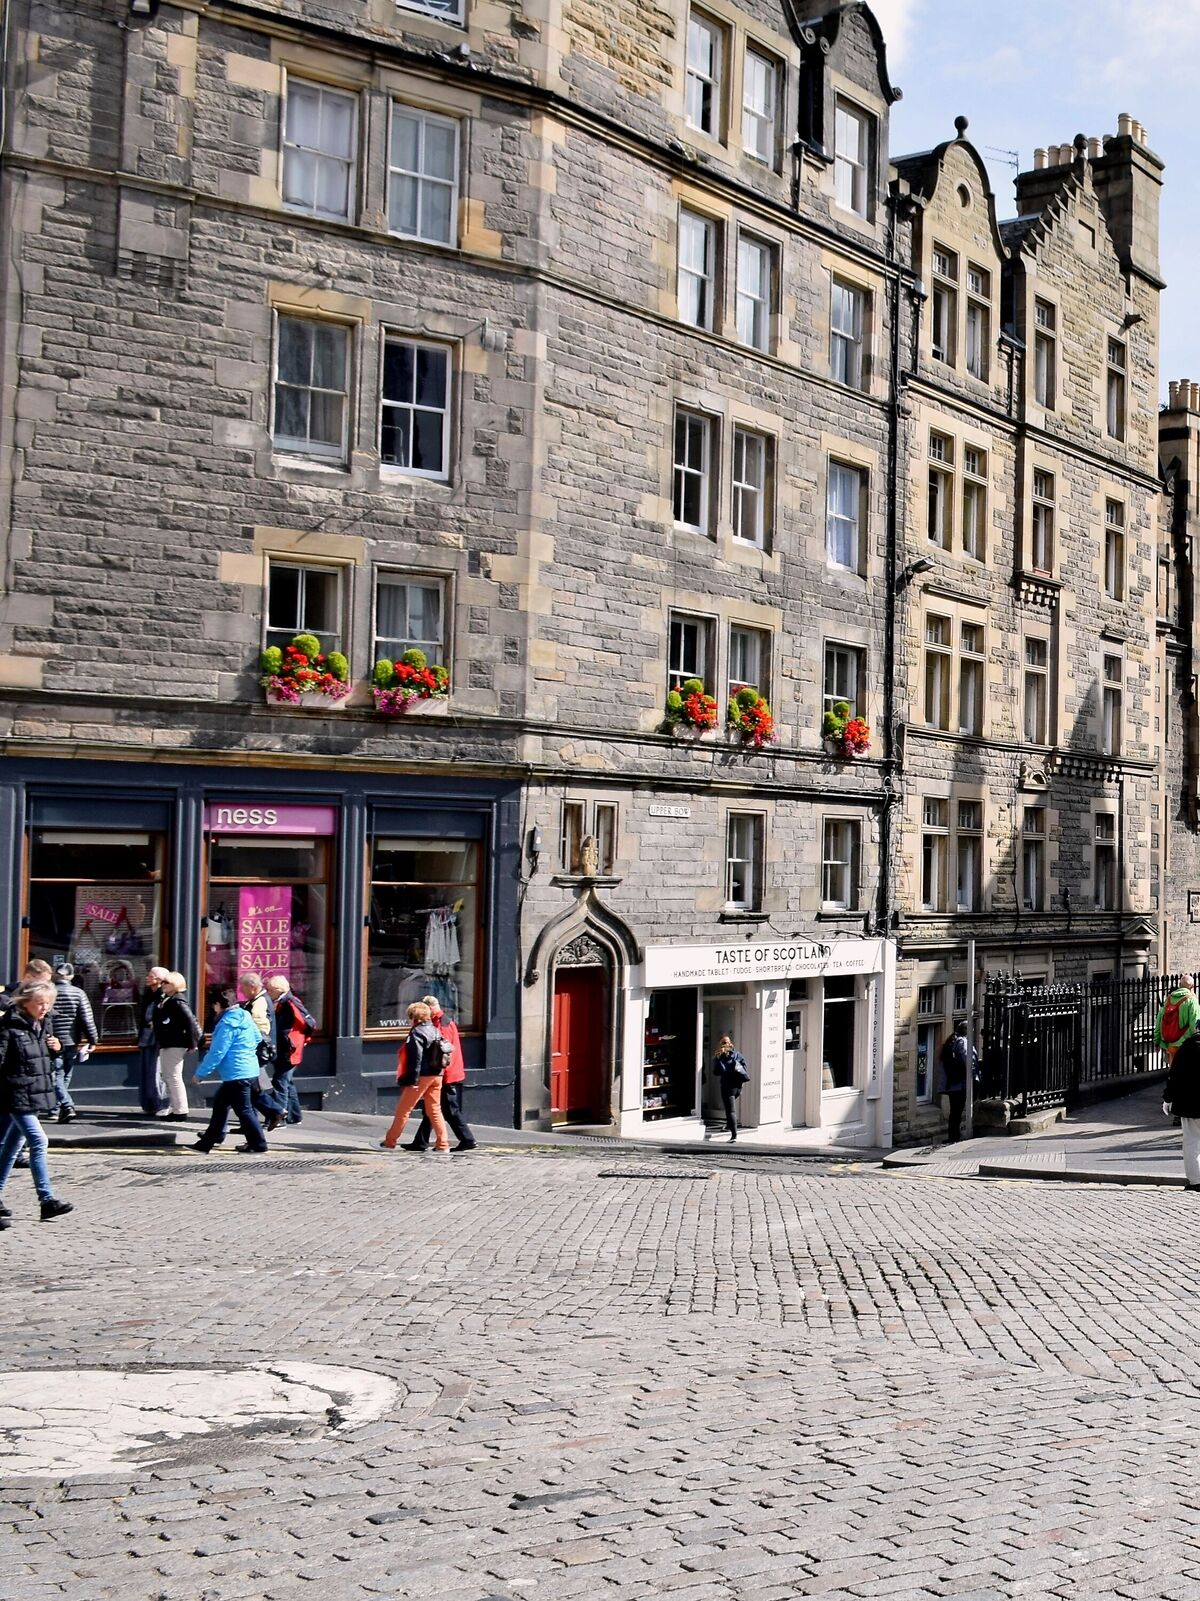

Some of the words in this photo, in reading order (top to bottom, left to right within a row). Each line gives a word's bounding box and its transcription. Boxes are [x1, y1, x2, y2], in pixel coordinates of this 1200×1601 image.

[217, 808, 277, 825] ness
[651, 806, 671, 815] UPPER
[674, 807, 688, 816] BOW
[88, 905, 119, 924] SALE
[241, 919, 290, 934] SALE
[241, 937, 289, 952] SALE
[240, 954, 289, 969] SALE
[715, 949, 751, 964] TASTE
[754, 948, 770, 962] OF
[673, 969, 706, 978] HANDMADE
[707, 968, 729, 976] TABLET
[733, 967, 752, 975] FUDGE
[755, 964, 792, 973] SHORTBREAD
[795, 962, 829, 971] CHOCOLATES
[873, 1020, 877, 1031] OF
